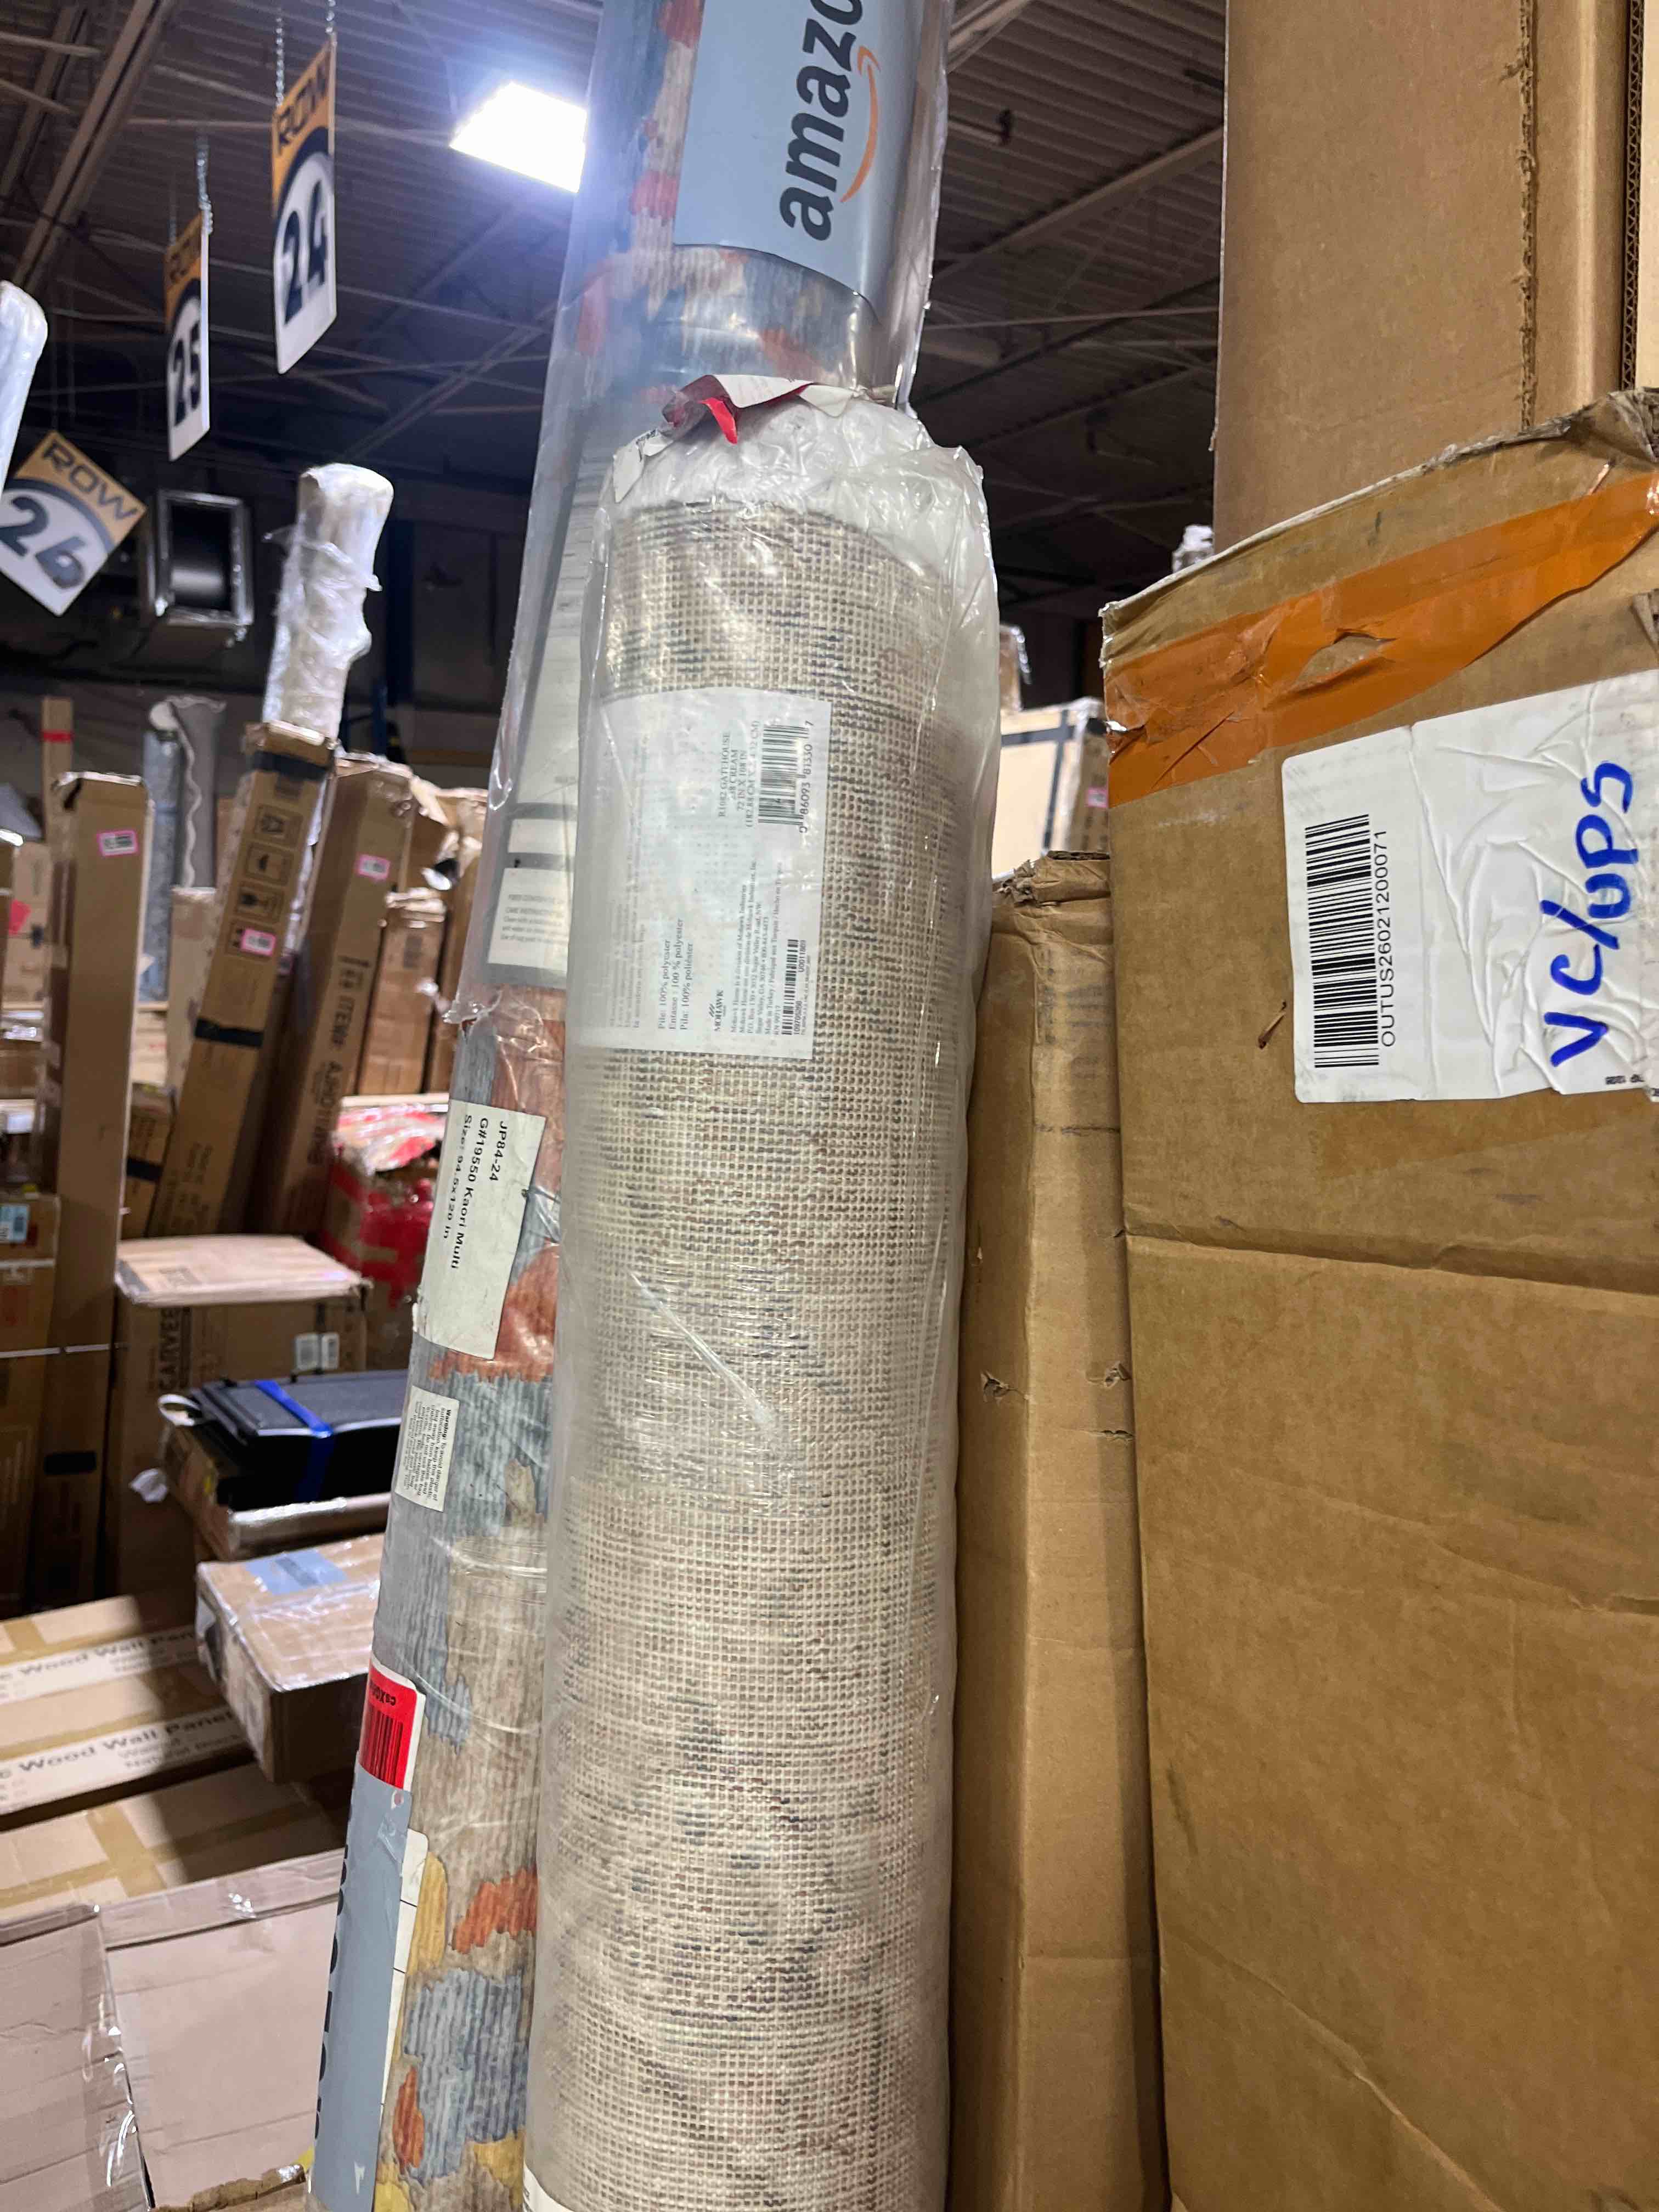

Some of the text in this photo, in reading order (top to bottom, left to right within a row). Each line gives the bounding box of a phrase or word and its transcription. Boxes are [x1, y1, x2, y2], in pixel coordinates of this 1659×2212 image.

[278, 60, 329, 153] ROW
[282, 180, 328, 325] 24
[173, 323, 201, 427] 25
[41, 438, 137, 521] ROW
[0, 496, 86, 590] 26
[720, 732, 730, 789] GATEHOUSE
[729, 749, 738, 783] CREAM
[740, 751, 747, 760] IN
[803, 744, 812, 775] 81330
[737, 790, 745, 799] IN
[747, 780, 755, 795] CM
[799, 782, 810, 815] 86093
[673, 918, 684, 959] polyester
[1373, 829, 1396, 1047] OUTUS26021200071
[661, 939, 671, 980] polyester
[672, 961, 680, 970] %
[659, 981, 668, 1006] 100%
[681, 983, 691, 1007] 100%
[713, 990, 724, 1032] MOHAWK
[766, 989, 776, 1009] Turkey
[730, 1008, 738, 1033] Mohawk
[489, 1120, 509, 1183] JP84-24
[443, 1114, 473, 1239] Size: 94.5x120 in
[450, 1117, 490, 1269] G#19550 Kaori Multi
[442, 1409, 452, 1440] Warning:
[427, 1477, 435, 1499] plastic
[433, 1470, 442, 1492] danger
[18, 1652, 88, 1676] Wood
[94, 1640, 144, 1658] Wall
[19, 1745, 97, 1773] Wood
[102, 1728, 159, 1750] Wall
